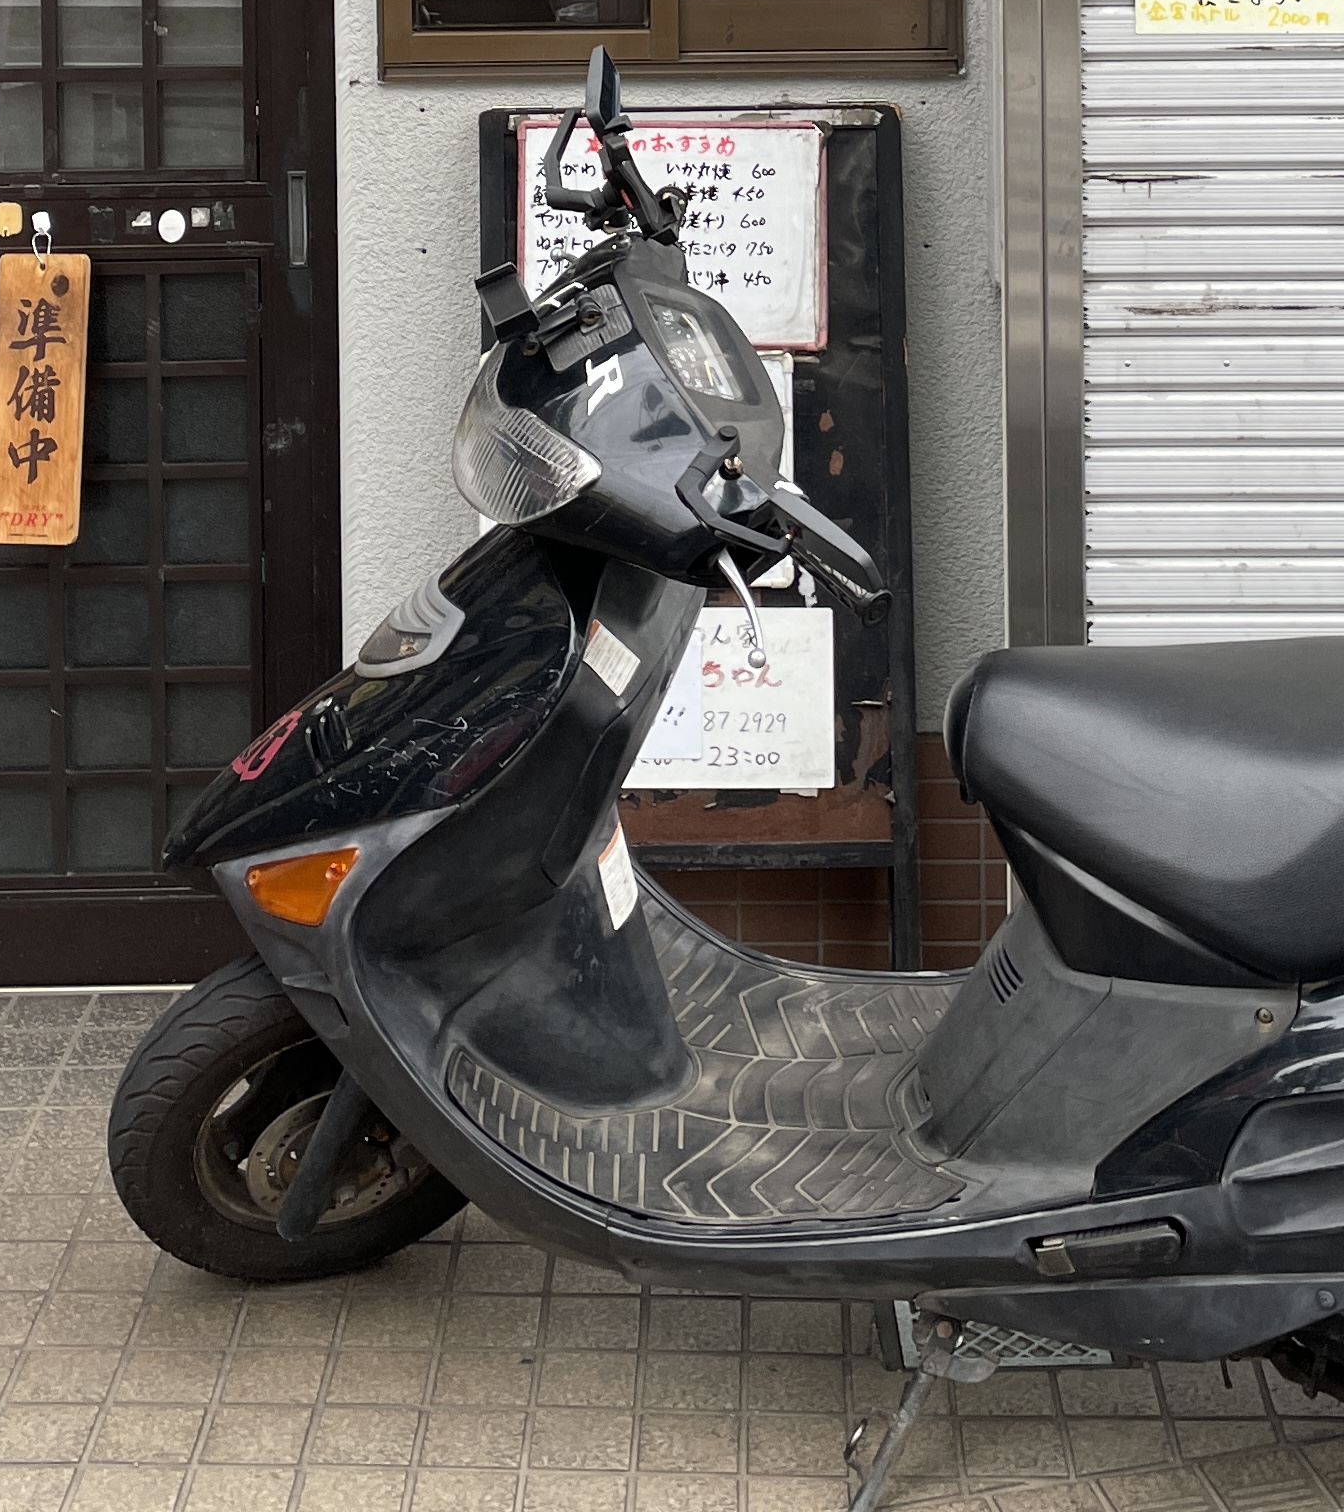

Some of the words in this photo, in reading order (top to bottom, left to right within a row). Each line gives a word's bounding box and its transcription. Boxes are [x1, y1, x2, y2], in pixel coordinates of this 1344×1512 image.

[752, 163, 776, 180] 600
[740, 213, 767, 229] 600
[746, 241, 774, 257] 750
[743, 270, 773, 288] 450
[7, 299, 67, 485] 準備中
[707, 745, 781, 767] 23:00
